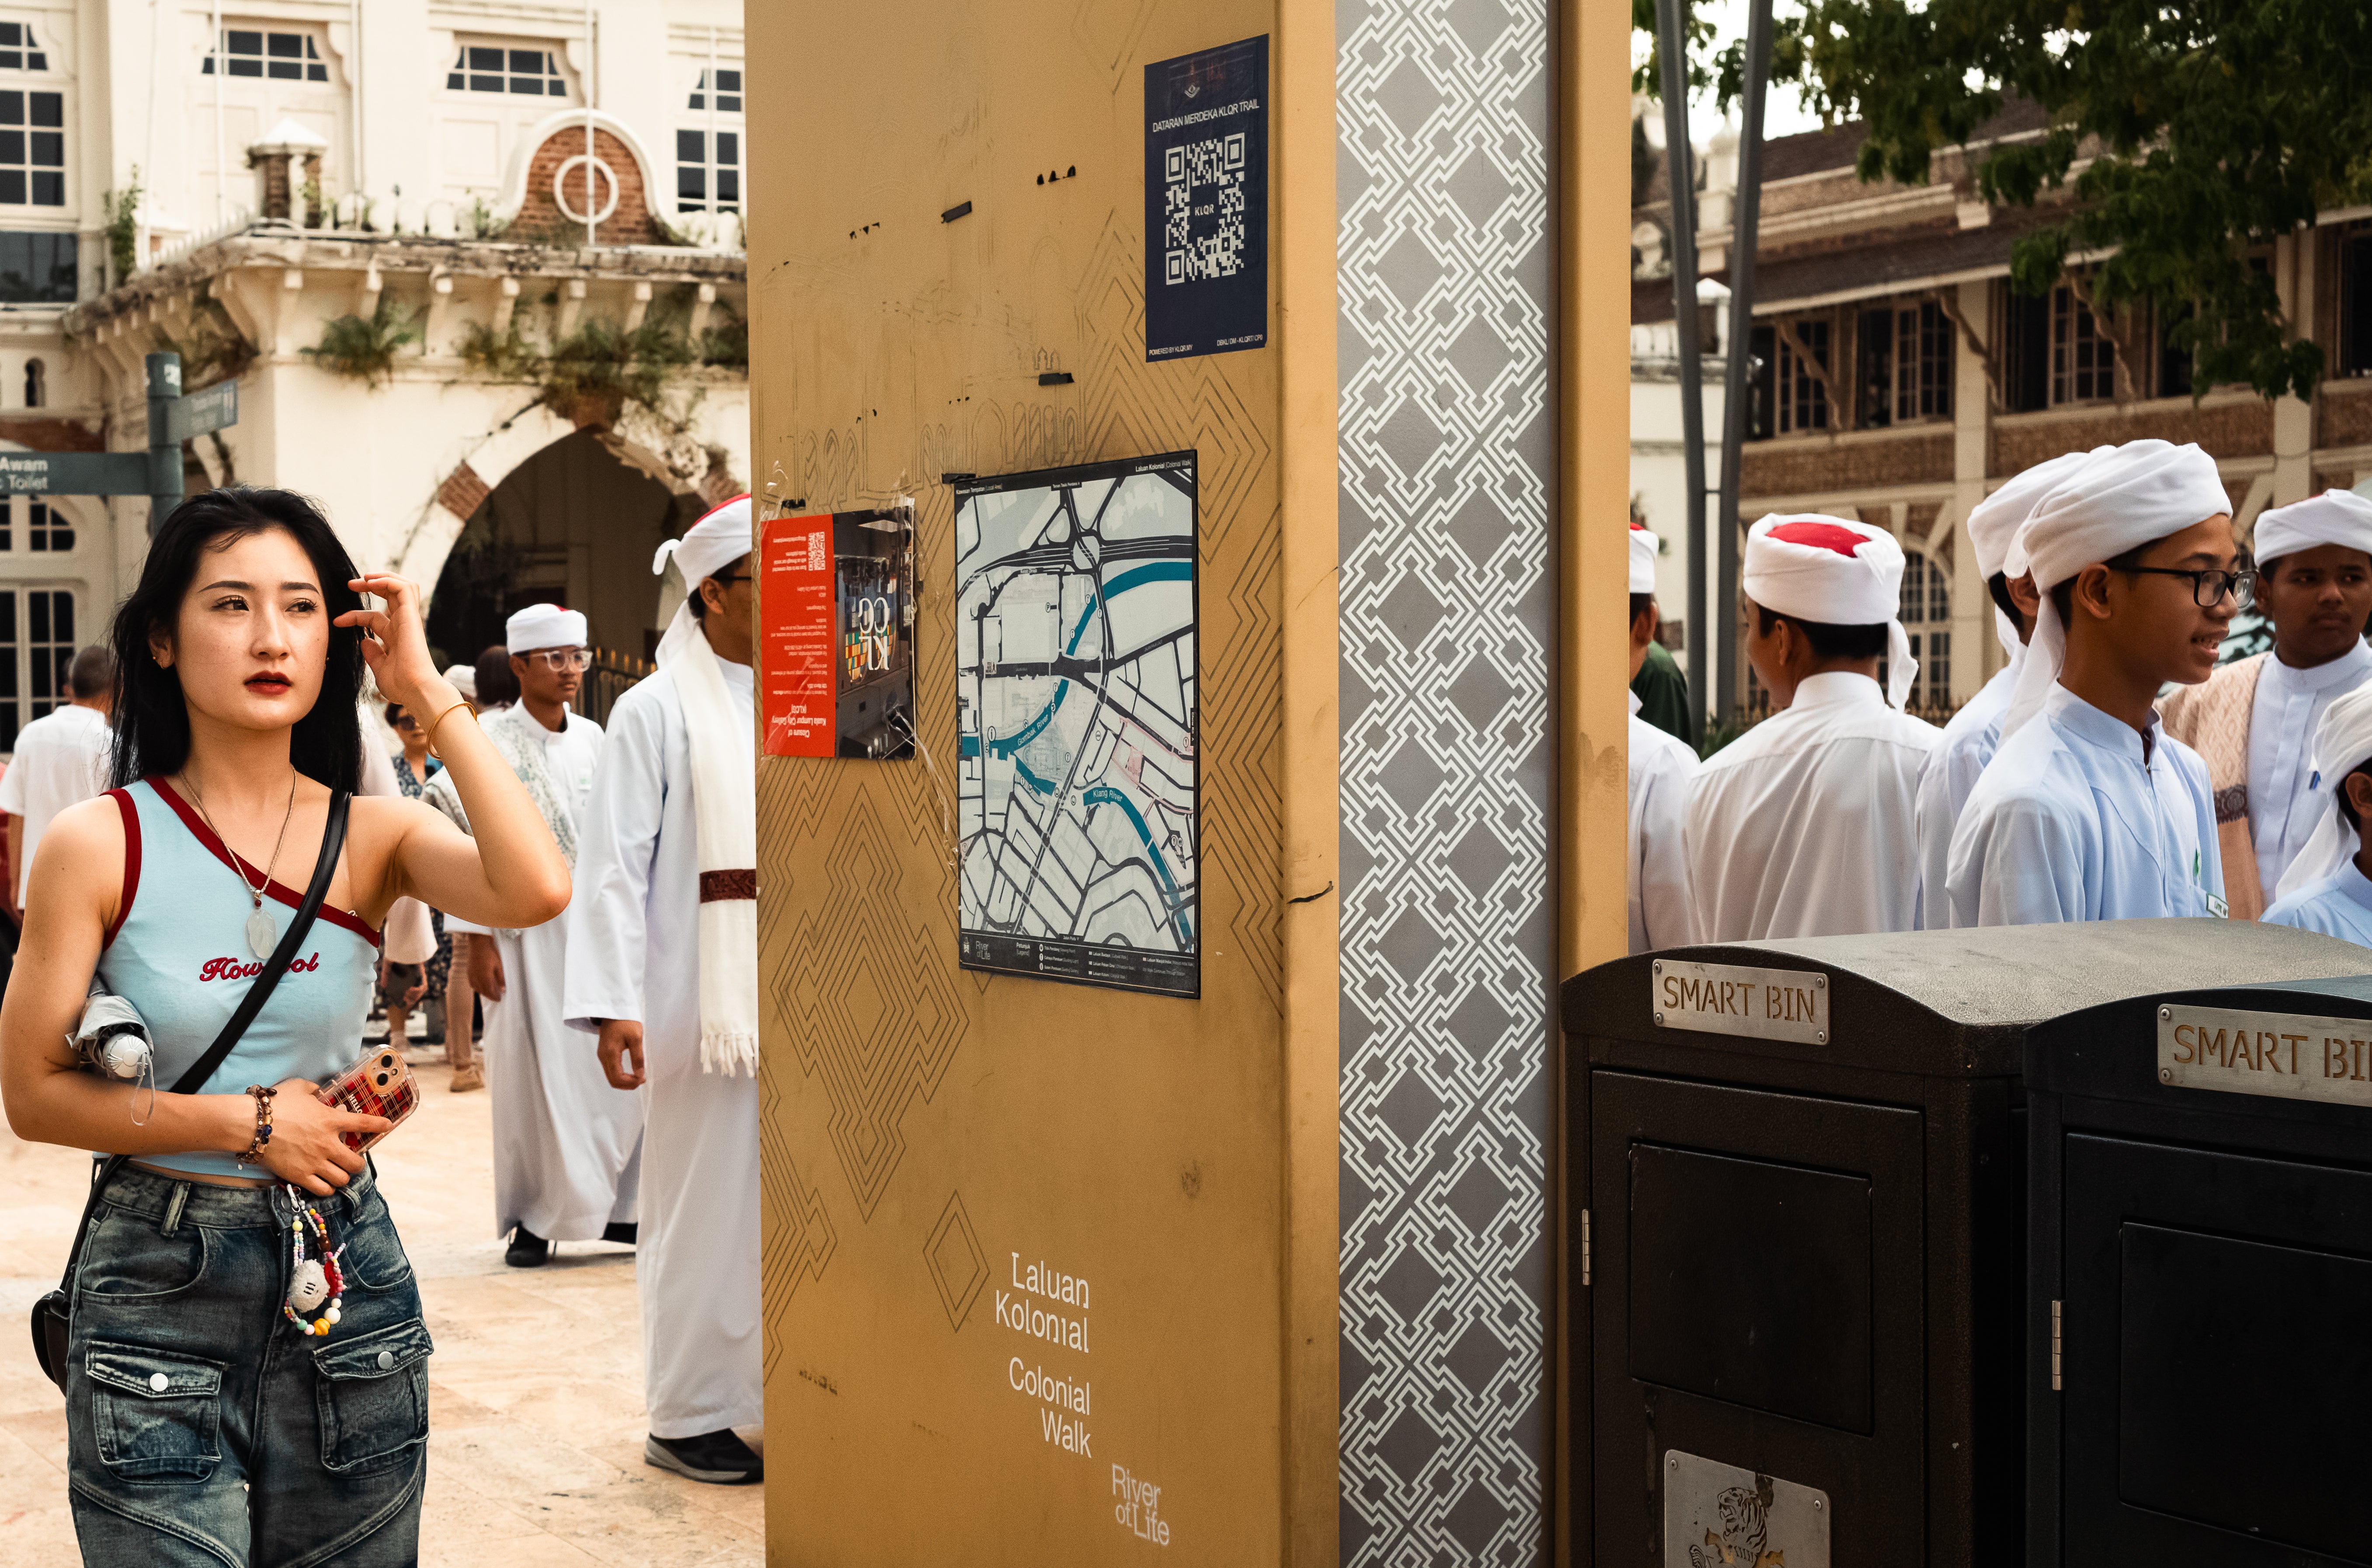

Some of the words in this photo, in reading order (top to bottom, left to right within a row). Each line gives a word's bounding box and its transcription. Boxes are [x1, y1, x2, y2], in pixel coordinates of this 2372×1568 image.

[1152, 116, 1183, 132] DATARAN
[1184, 108, 1218, 125] MERDEKA
[1219, 103, 1238, 116] KLQR
[1239, 98, 1260, 112] TRAIL
[1195, 204, 1214, 216] KLQR
[1149, 347, 1169, 356] POWERED
[0, 457, 48, 472] Awam
[1149, 462, 1165, 470] Kolonial
[7, 474, 48, 489] Toilet
[858, 597, 889, 634] CG
[858, 635, 889, 670] KL
[788, 729, 793, 737] of
[793, 729, 810, 739] Closure
[796, 716, 813, 726] Lumpur
[814, 718, 827, 726] Kuala
[1017, 727, 1036, 746] Gombak
[1036, 714, 1049, 730] River
[1093, 789, 1108, 798] Klang
[1109, 790, 1122, 801] River
[976, 940, 989, 951] River
[1664, 975, 1756, 1016] SMART
[1766, 985, 1815, 1023] BIN
[2174, 1023, 2309, 1075] SMART
[2324, 1037, 2372, 1082] BI
[1011, 1252, 1089, 1309] Laluan
[996, 1290, 1089, 1354] Kolonial
[1009, 1357, 1090, 1415] Colonial
[1041, 1407, 1092, 1459] Walk
[1111, 1463, 1161, 1509] River
[1132, 1502, 1170, 1546] Life
